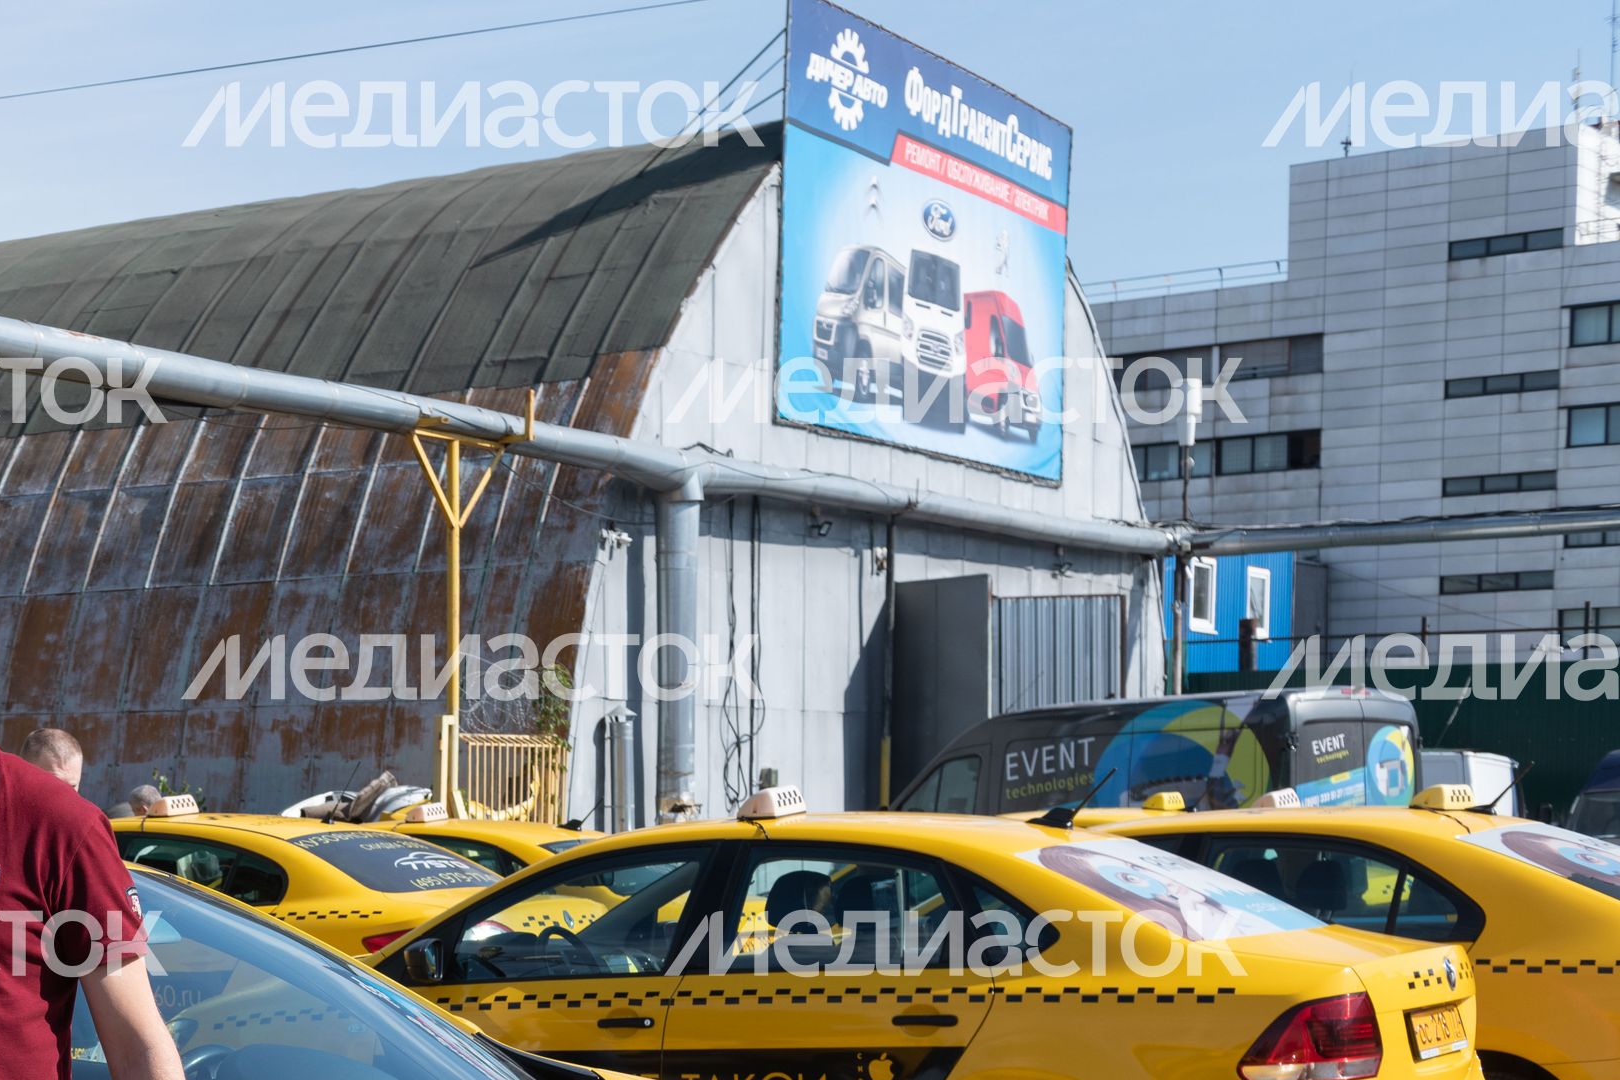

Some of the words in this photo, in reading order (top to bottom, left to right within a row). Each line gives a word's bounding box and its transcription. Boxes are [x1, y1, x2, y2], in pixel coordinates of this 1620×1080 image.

[905, 142, 941, 174] РЕМОНТ
[1312, 733, 1345, 755] EVENT
[1006, 737, 1095, 781] EVENT
[1007, 772, 1094, 800] technologies
[410, 876, 448, 890] (495)
